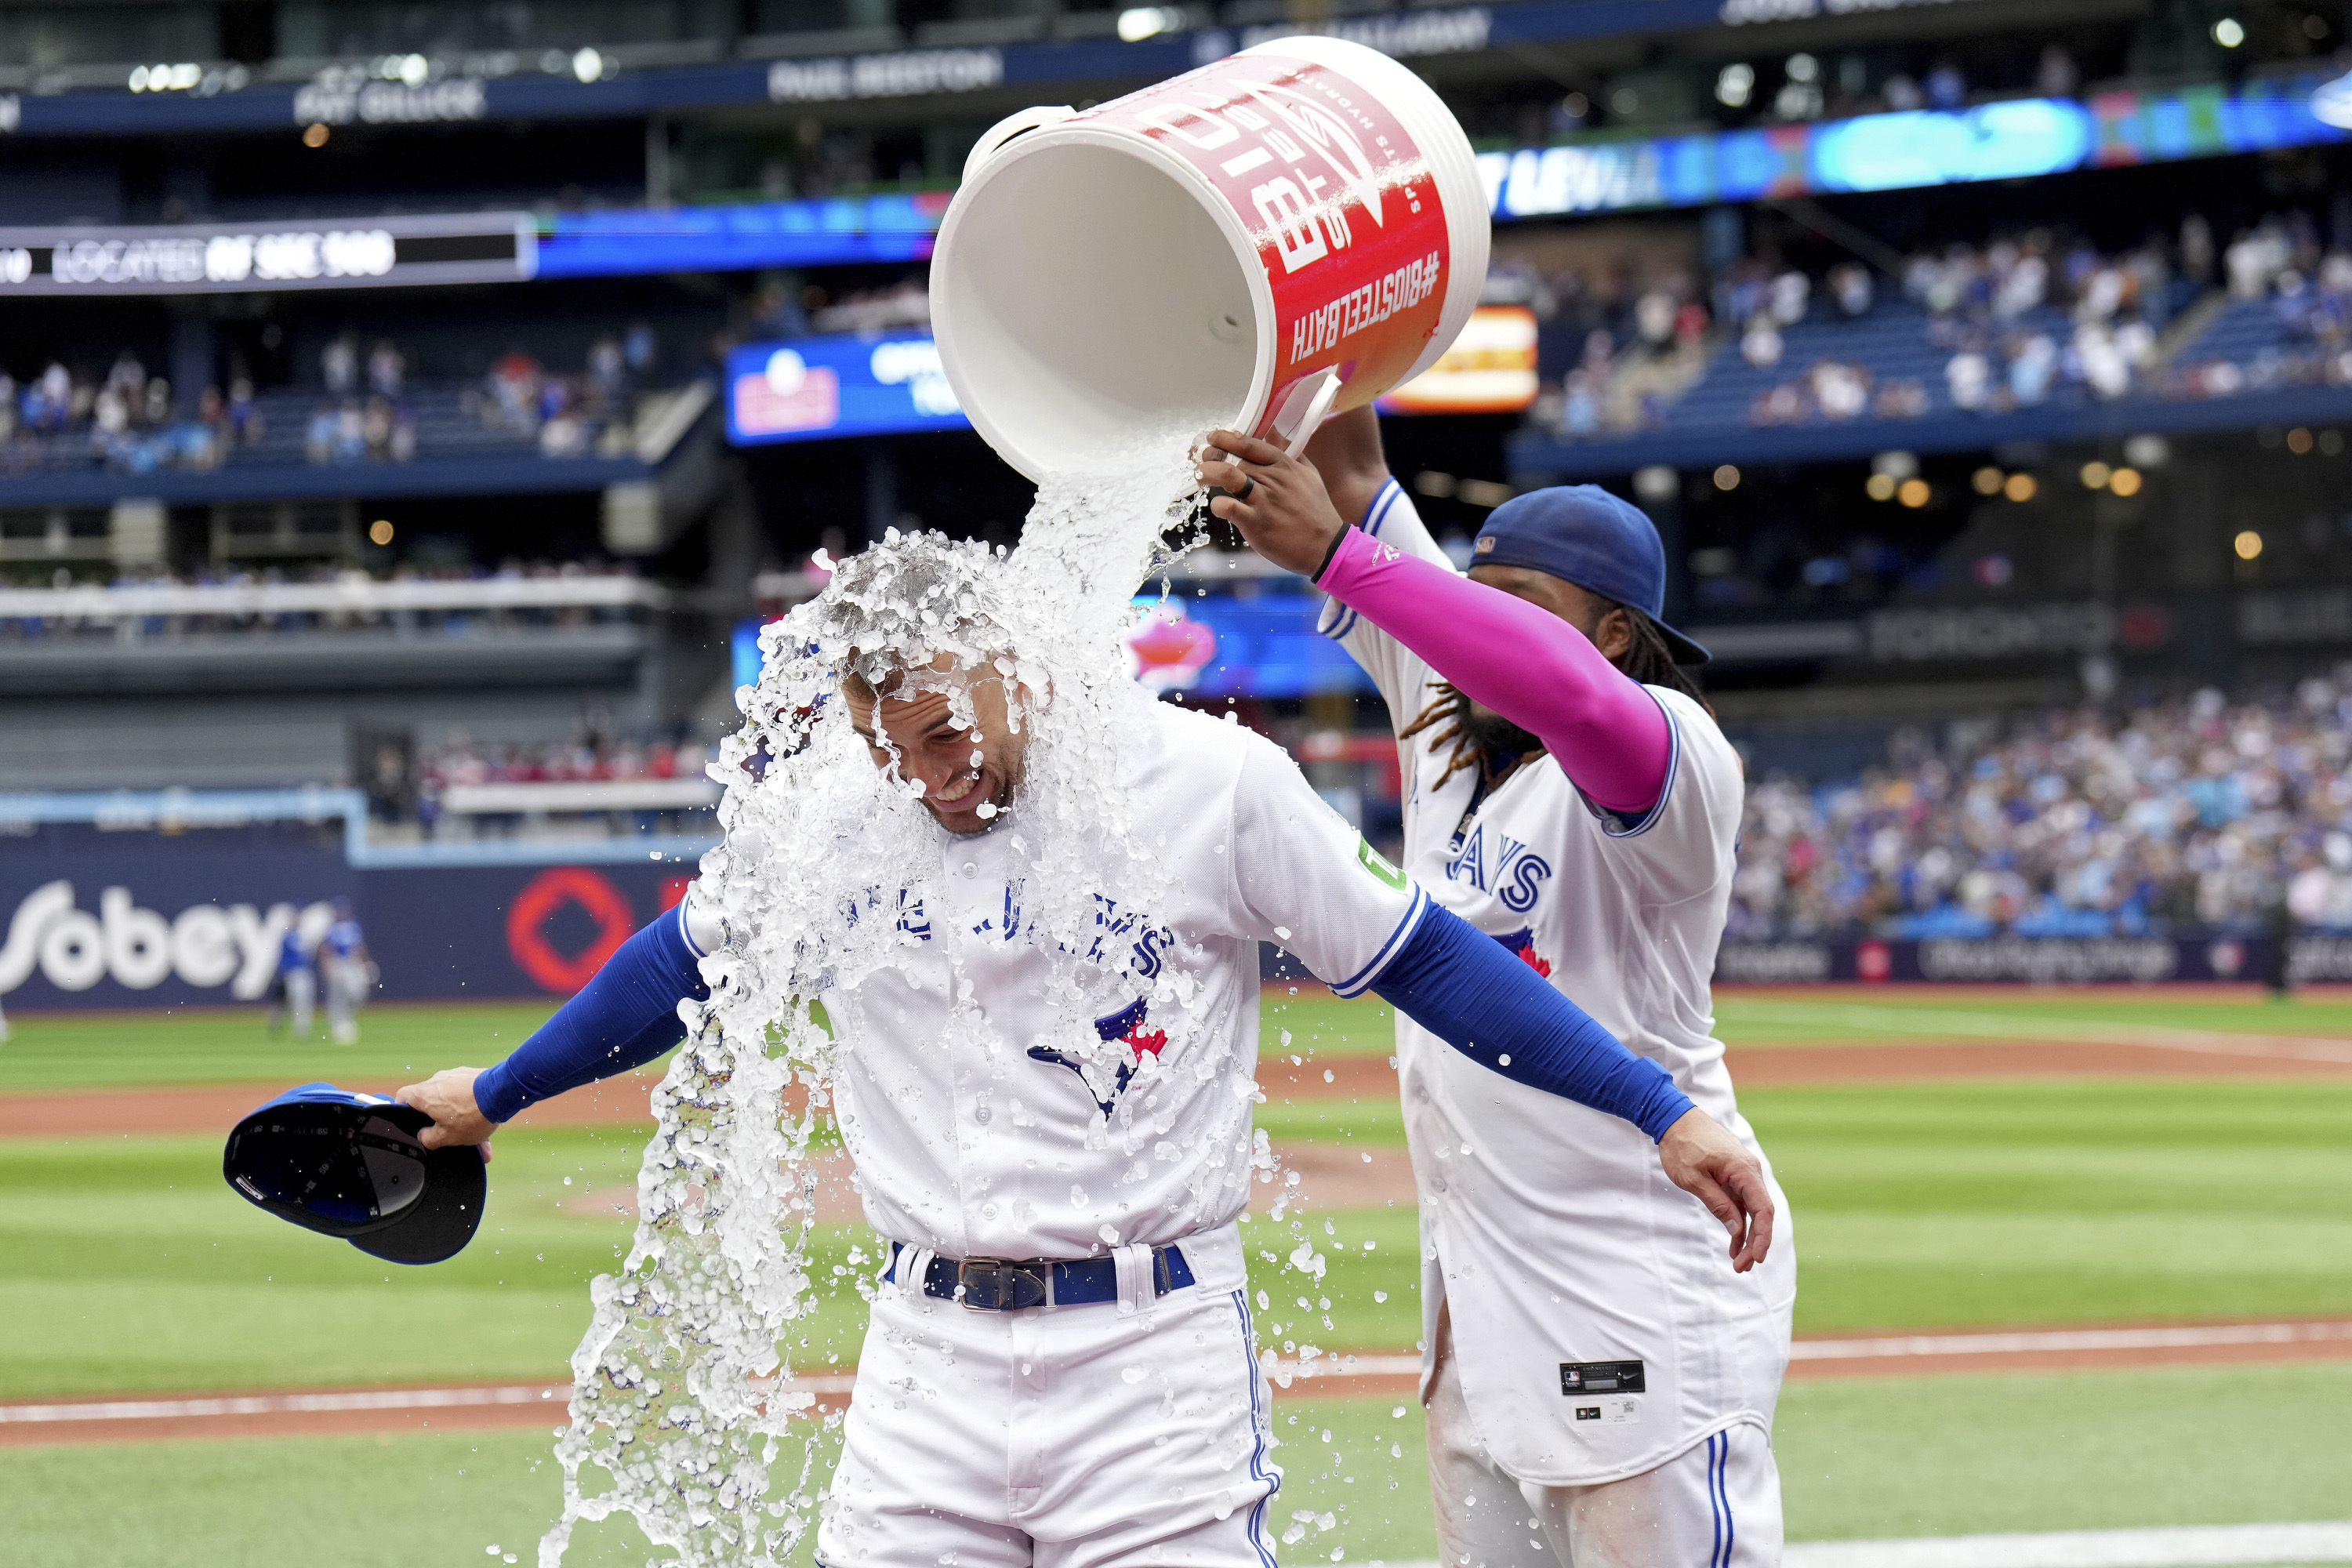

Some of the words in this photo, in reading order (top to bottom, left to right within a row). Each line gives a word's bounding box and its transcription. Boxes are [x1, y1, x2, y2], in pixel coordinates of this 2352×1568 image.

[1268, 64, 1374, 129] HYDRATION
[52, 238, 205, 283] LOCATED
[1290, 250, 1440, 365] #BIOSTEELBATH
[972, 877, 1175, 980] JYS
